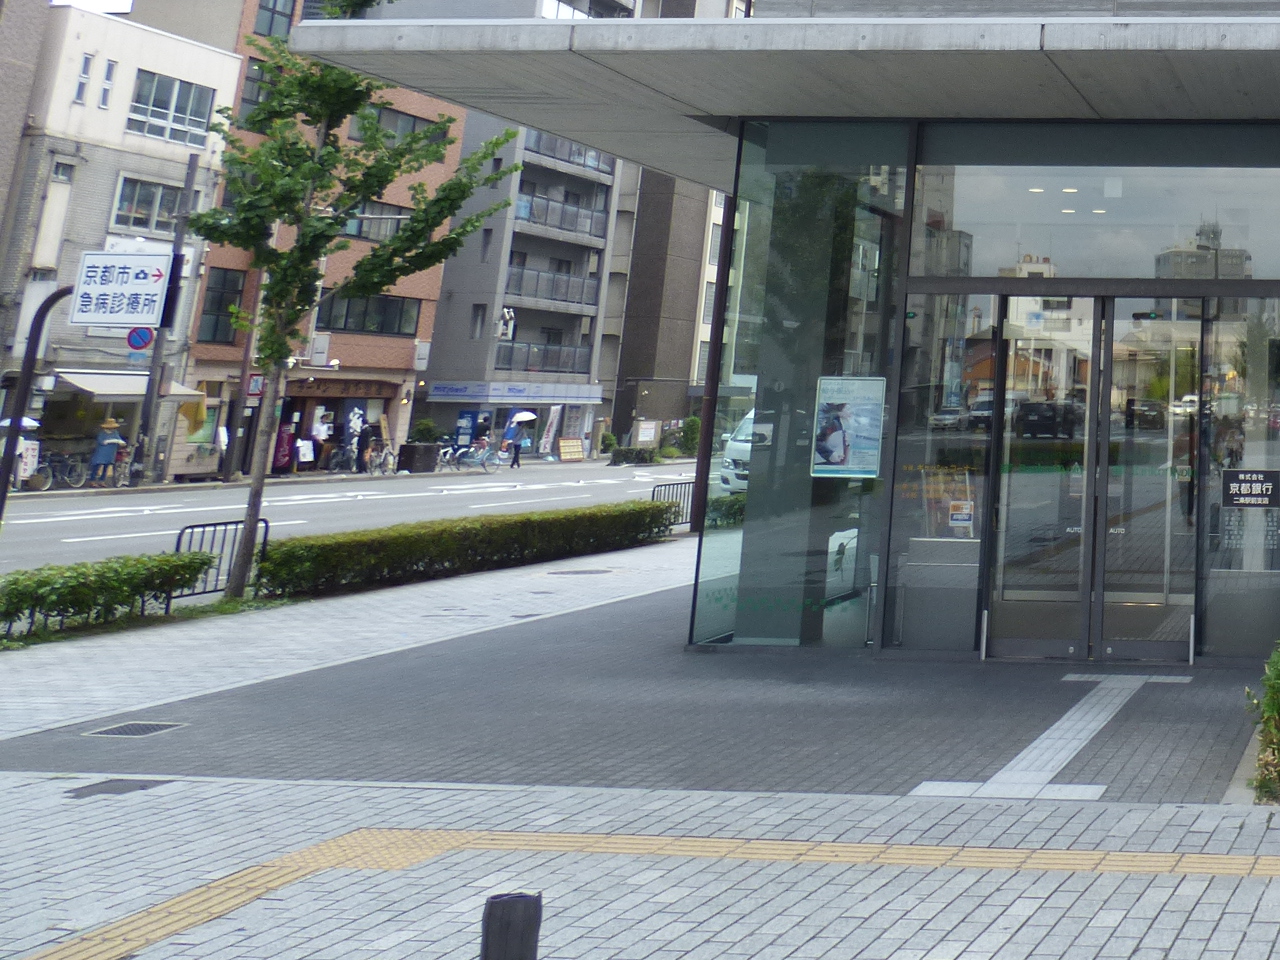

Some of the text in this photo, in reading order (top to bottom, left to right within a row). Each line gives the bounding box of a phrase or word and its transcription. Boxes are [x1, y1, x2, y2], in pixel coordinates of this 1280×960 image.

[83, 264, 132, 286] 京都市
[77, 291, 158, 314] 急病診療所
[1229, 482, 1273, 495] 京都銀行
[1109, 527, 1126, 535] AUTO
